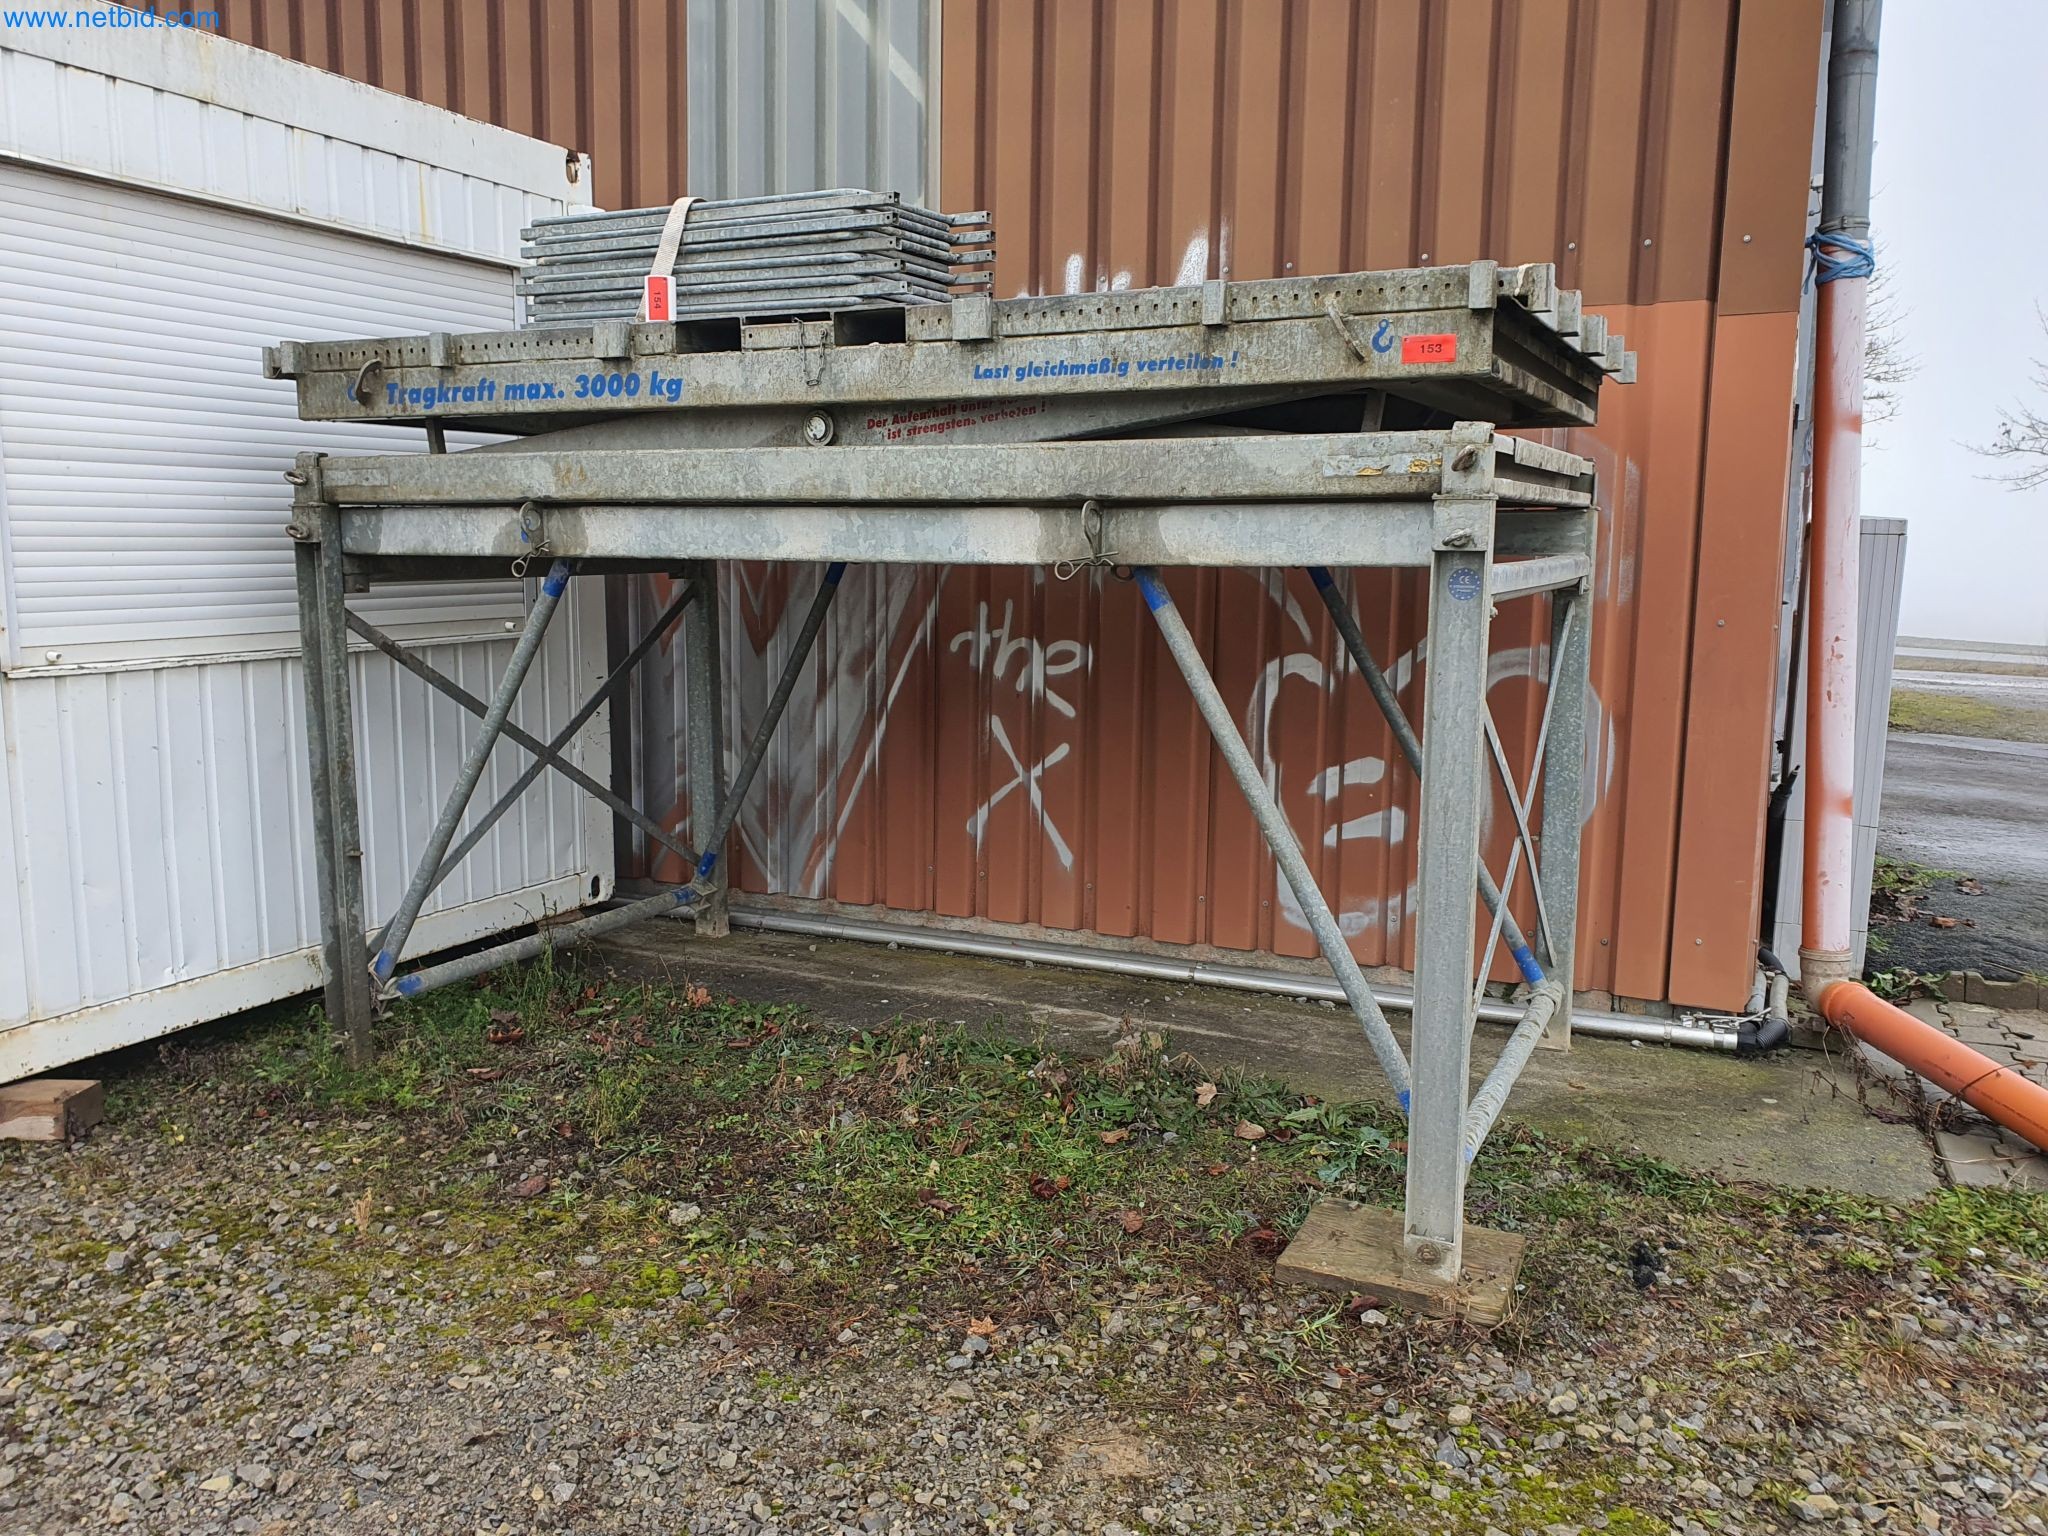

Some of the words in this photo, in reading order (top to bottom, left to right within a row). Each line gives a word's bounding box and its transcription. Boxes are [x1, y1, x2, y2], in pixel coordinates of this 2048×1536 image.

[653, 291, 662, 309] 154
[1420, 343, 1442, 354] 153
[974, 364, 1009, 380] Last
[1015, 357, 1130, 382] gleichmäßig
[386, 377, 497, 410] Tragkraft
[504, 383, 565, 401] max.
[575, 373, 641, 399] 3000
[650, 370, 683, 402] kg
[867, 417, 889, 430] Der
[887, 428, 902, 440] ist
